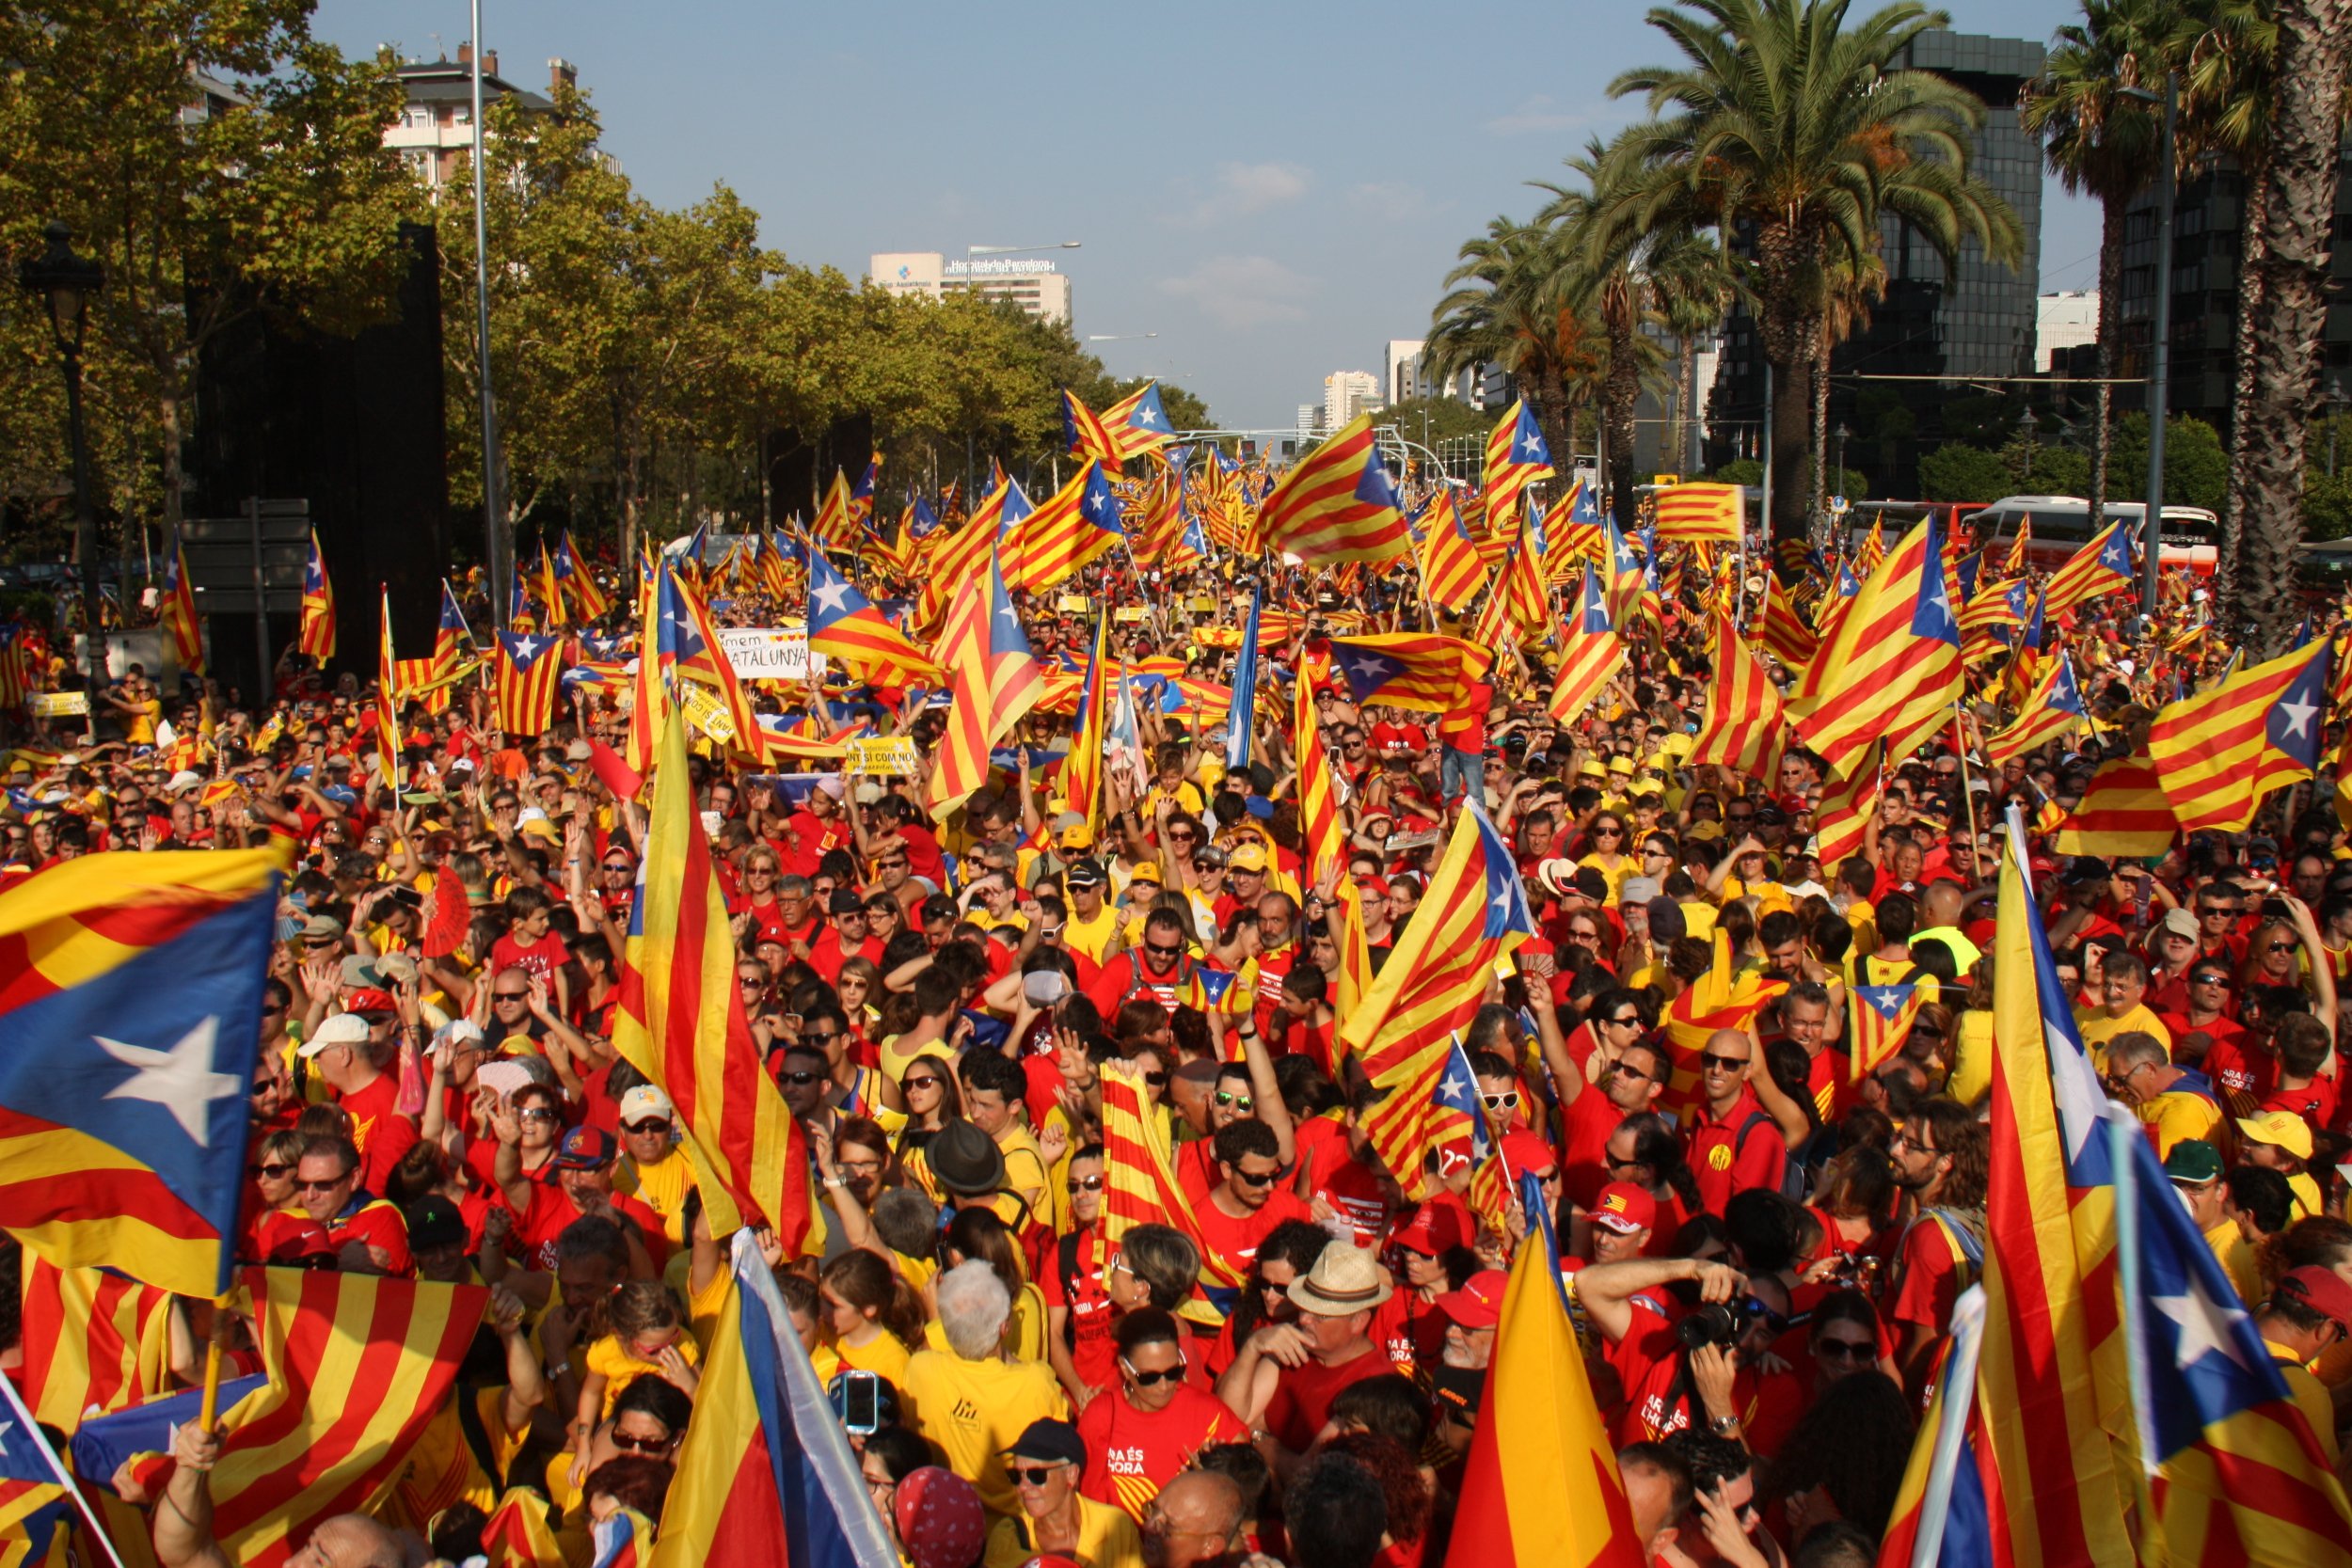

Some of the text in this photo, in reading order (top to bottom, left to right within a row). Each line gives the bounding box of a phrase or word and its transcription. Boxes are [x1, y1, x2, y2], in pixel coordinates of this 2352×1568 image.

[951, 259, 987, 270] Hospital
[1004, 258, 1050, 269] Barcelona
[731, 647, 808, 667] ATALUNYA
[846, 752, 861, 762] ANT
[875, 752, 897, 762] COM
[1126, 1446, 1144, 1462] ÉS
[1108, 1459, 1145, 1475] HORA
